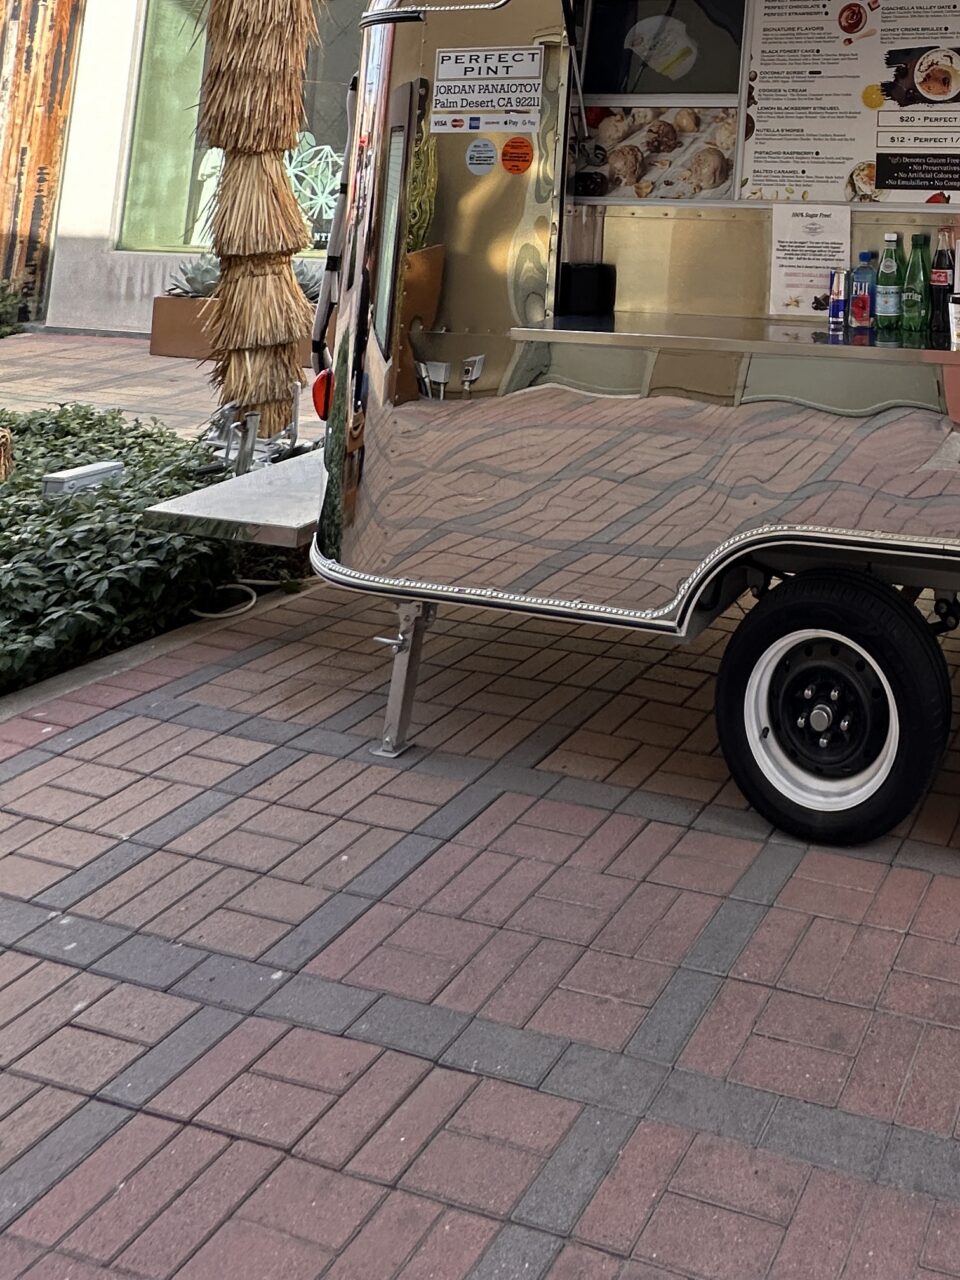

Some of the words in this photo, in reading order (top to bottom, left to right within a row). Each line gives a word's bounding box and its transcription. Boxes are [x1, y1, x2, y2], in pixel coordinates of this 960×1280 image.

[441, 53, 539, 64] PERFECT
[464, 66, 513, 75] PINT
[435, 84, 475, 97] JORDAN
[478, 83, 540, 94] PANAIOTOV
[434, 99, 457, 108] Palm
[461, 98, 495, 108] Desert,
[498, 98, 513, 107] CA
[516, 97, 539, 107] 92211
[853, 282, 868, 295] FIJI
